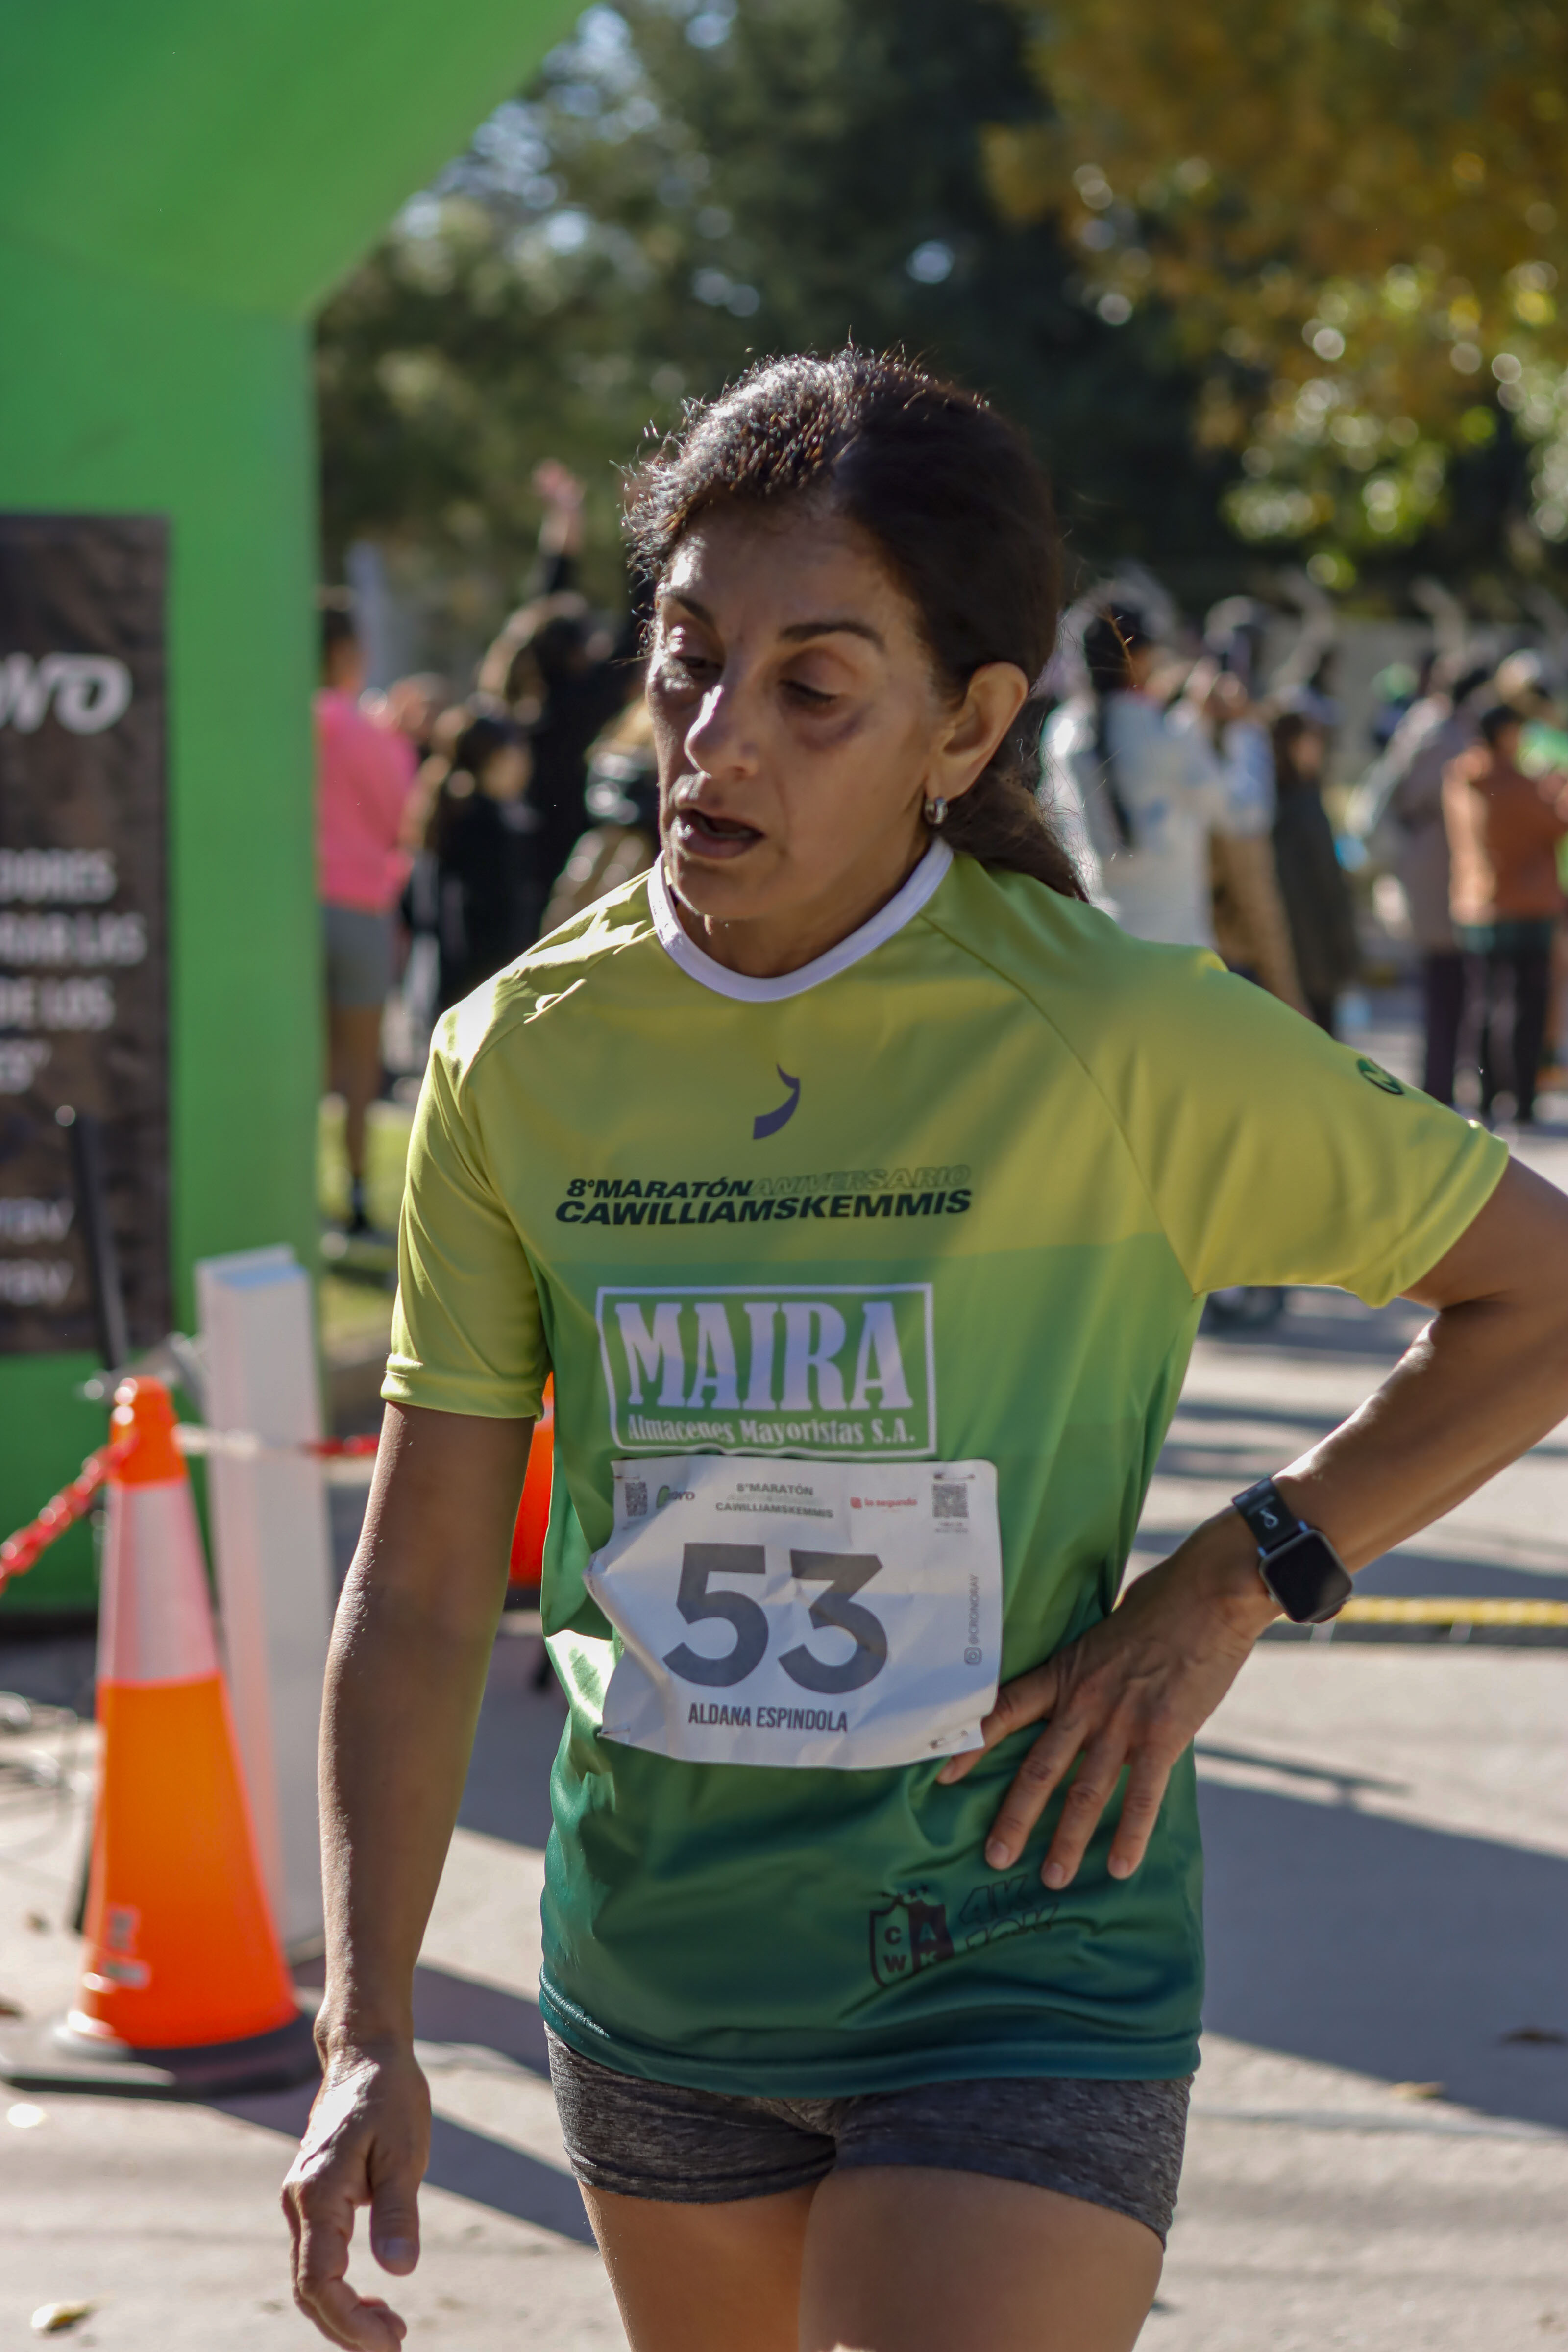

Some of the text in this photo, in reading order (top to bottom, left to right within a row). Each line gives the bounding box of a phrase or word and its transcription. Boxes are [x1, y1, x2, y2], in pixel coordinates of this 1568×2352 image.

[556, 1189, 972, 1225] CAWILLIAMSKEMMIS
[615, 1301, 913, 1411] MAIRA
[628, 1414, 915, 1445] Almacenes Mayoristas S.A.
[662, 1543, 888, 1694] 53
[689, 1703, 848, 1733] ALDANA ESPINDOLA
